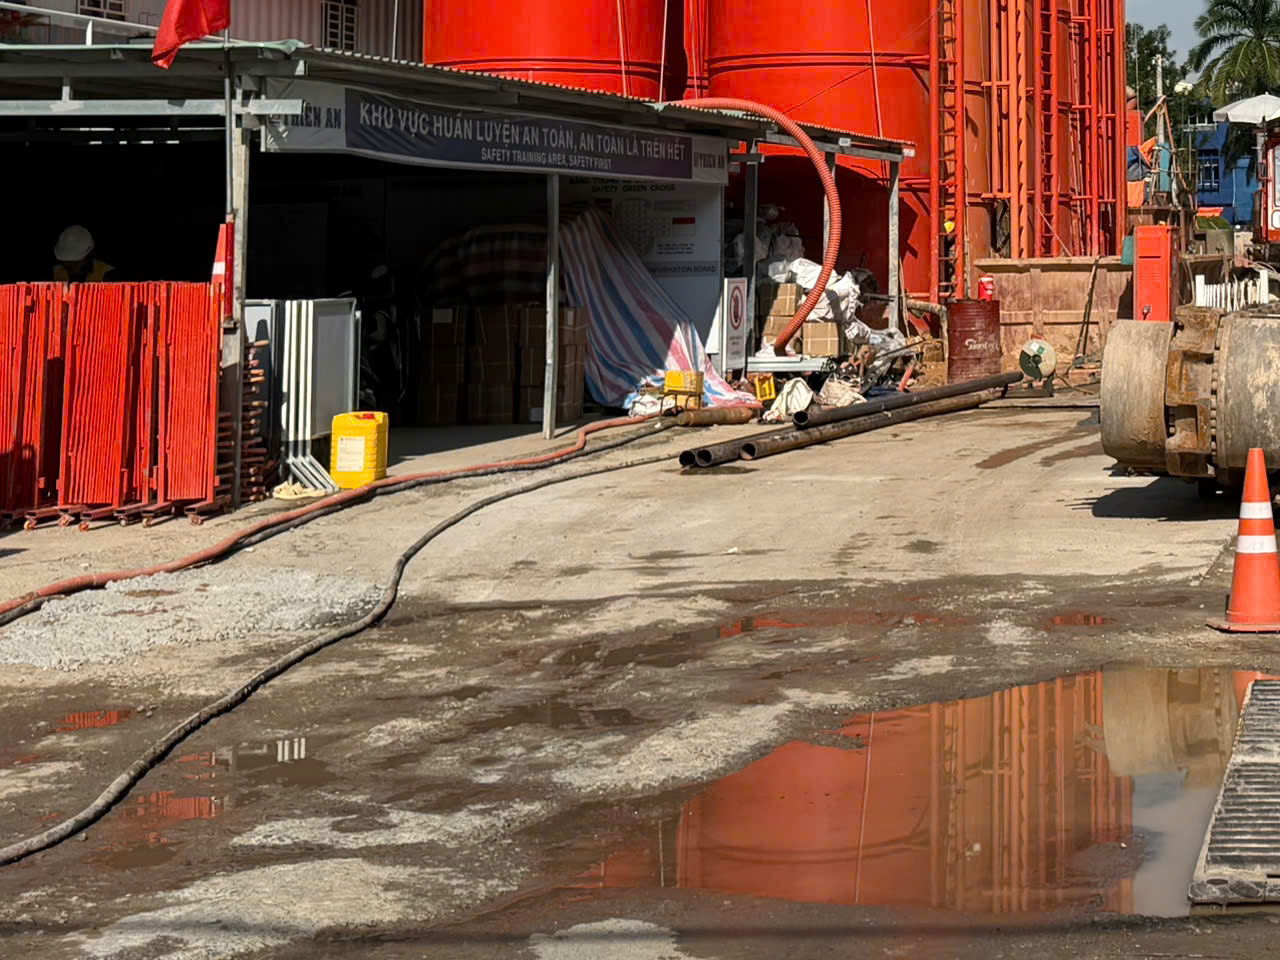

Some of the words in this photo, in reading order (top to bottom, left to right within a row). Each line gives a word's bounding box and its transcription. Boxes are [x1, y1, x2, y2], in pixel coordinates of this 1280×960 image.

[360, 102, 394, 129] KHU
[399, 109, 429, 137] VỰC
[476, 118, 520, 147] LUYỆN
[523, 126, 539, 147] AN
[580, 133, 594, 152] AN
[596, 132, 624, 155] TOÀN
[481, 147, 510, 161] SAFETY
[512, 150, 547, 165] TRAINING
[569, 156, 594, 169] SAFETY
